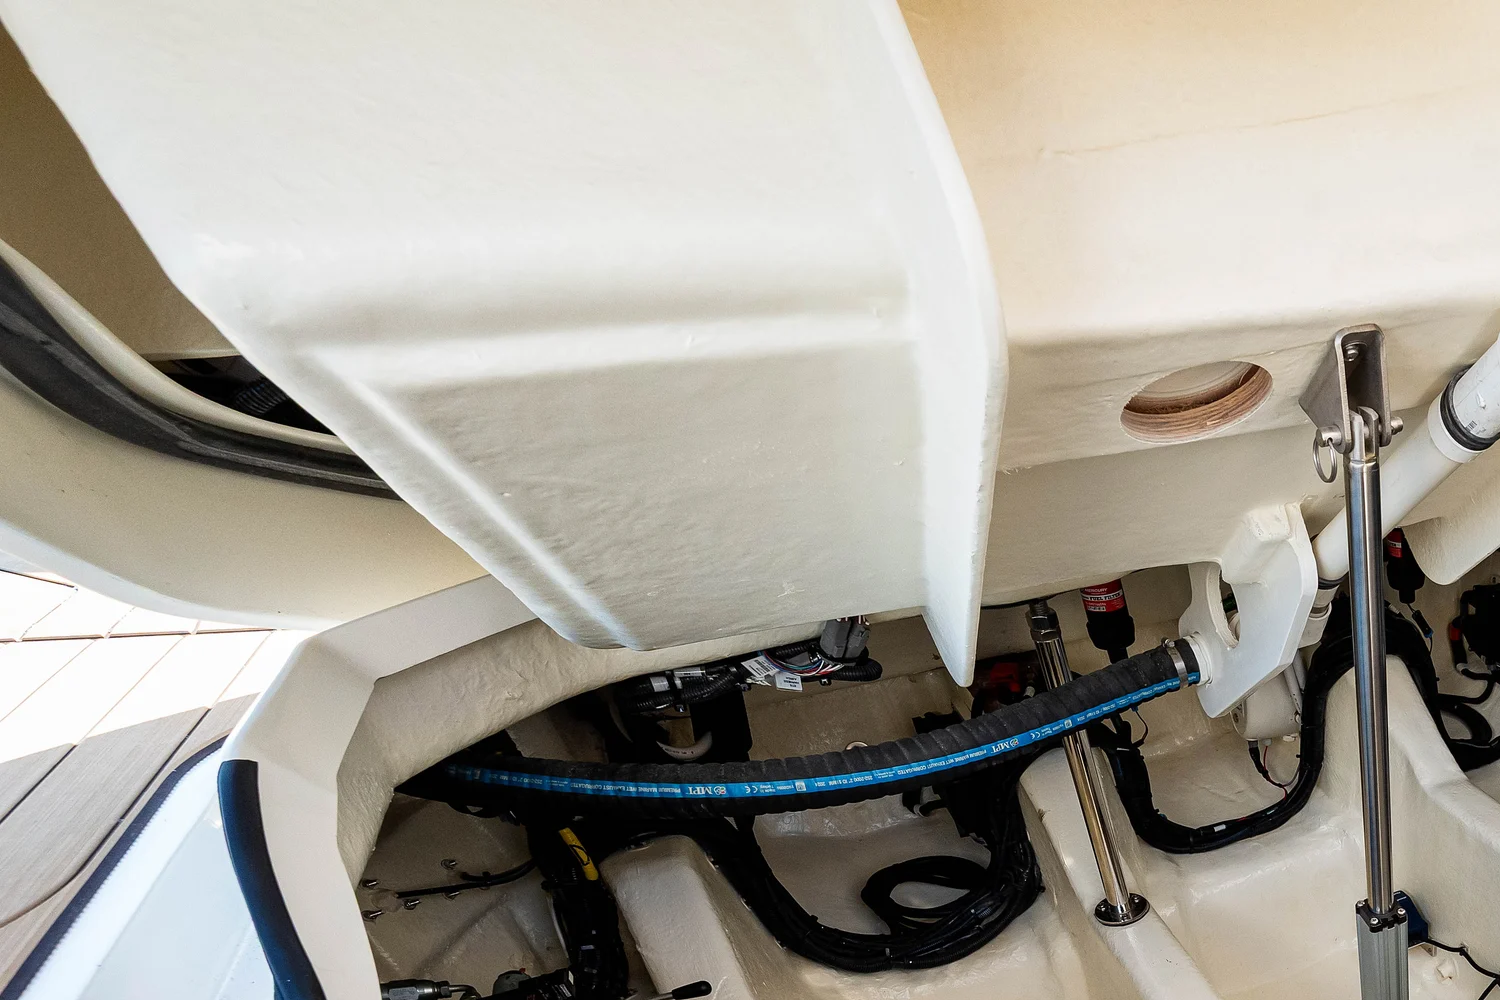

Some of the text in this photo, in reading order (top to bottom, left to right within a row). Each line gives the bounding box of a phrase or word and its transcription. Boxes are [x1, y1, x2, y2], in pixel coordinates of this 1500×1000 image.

[991, 741, 1009, 753] MPI
[897, 764, 925, 775] CORRUGATED
[688, 786, 712, 794] MPI
